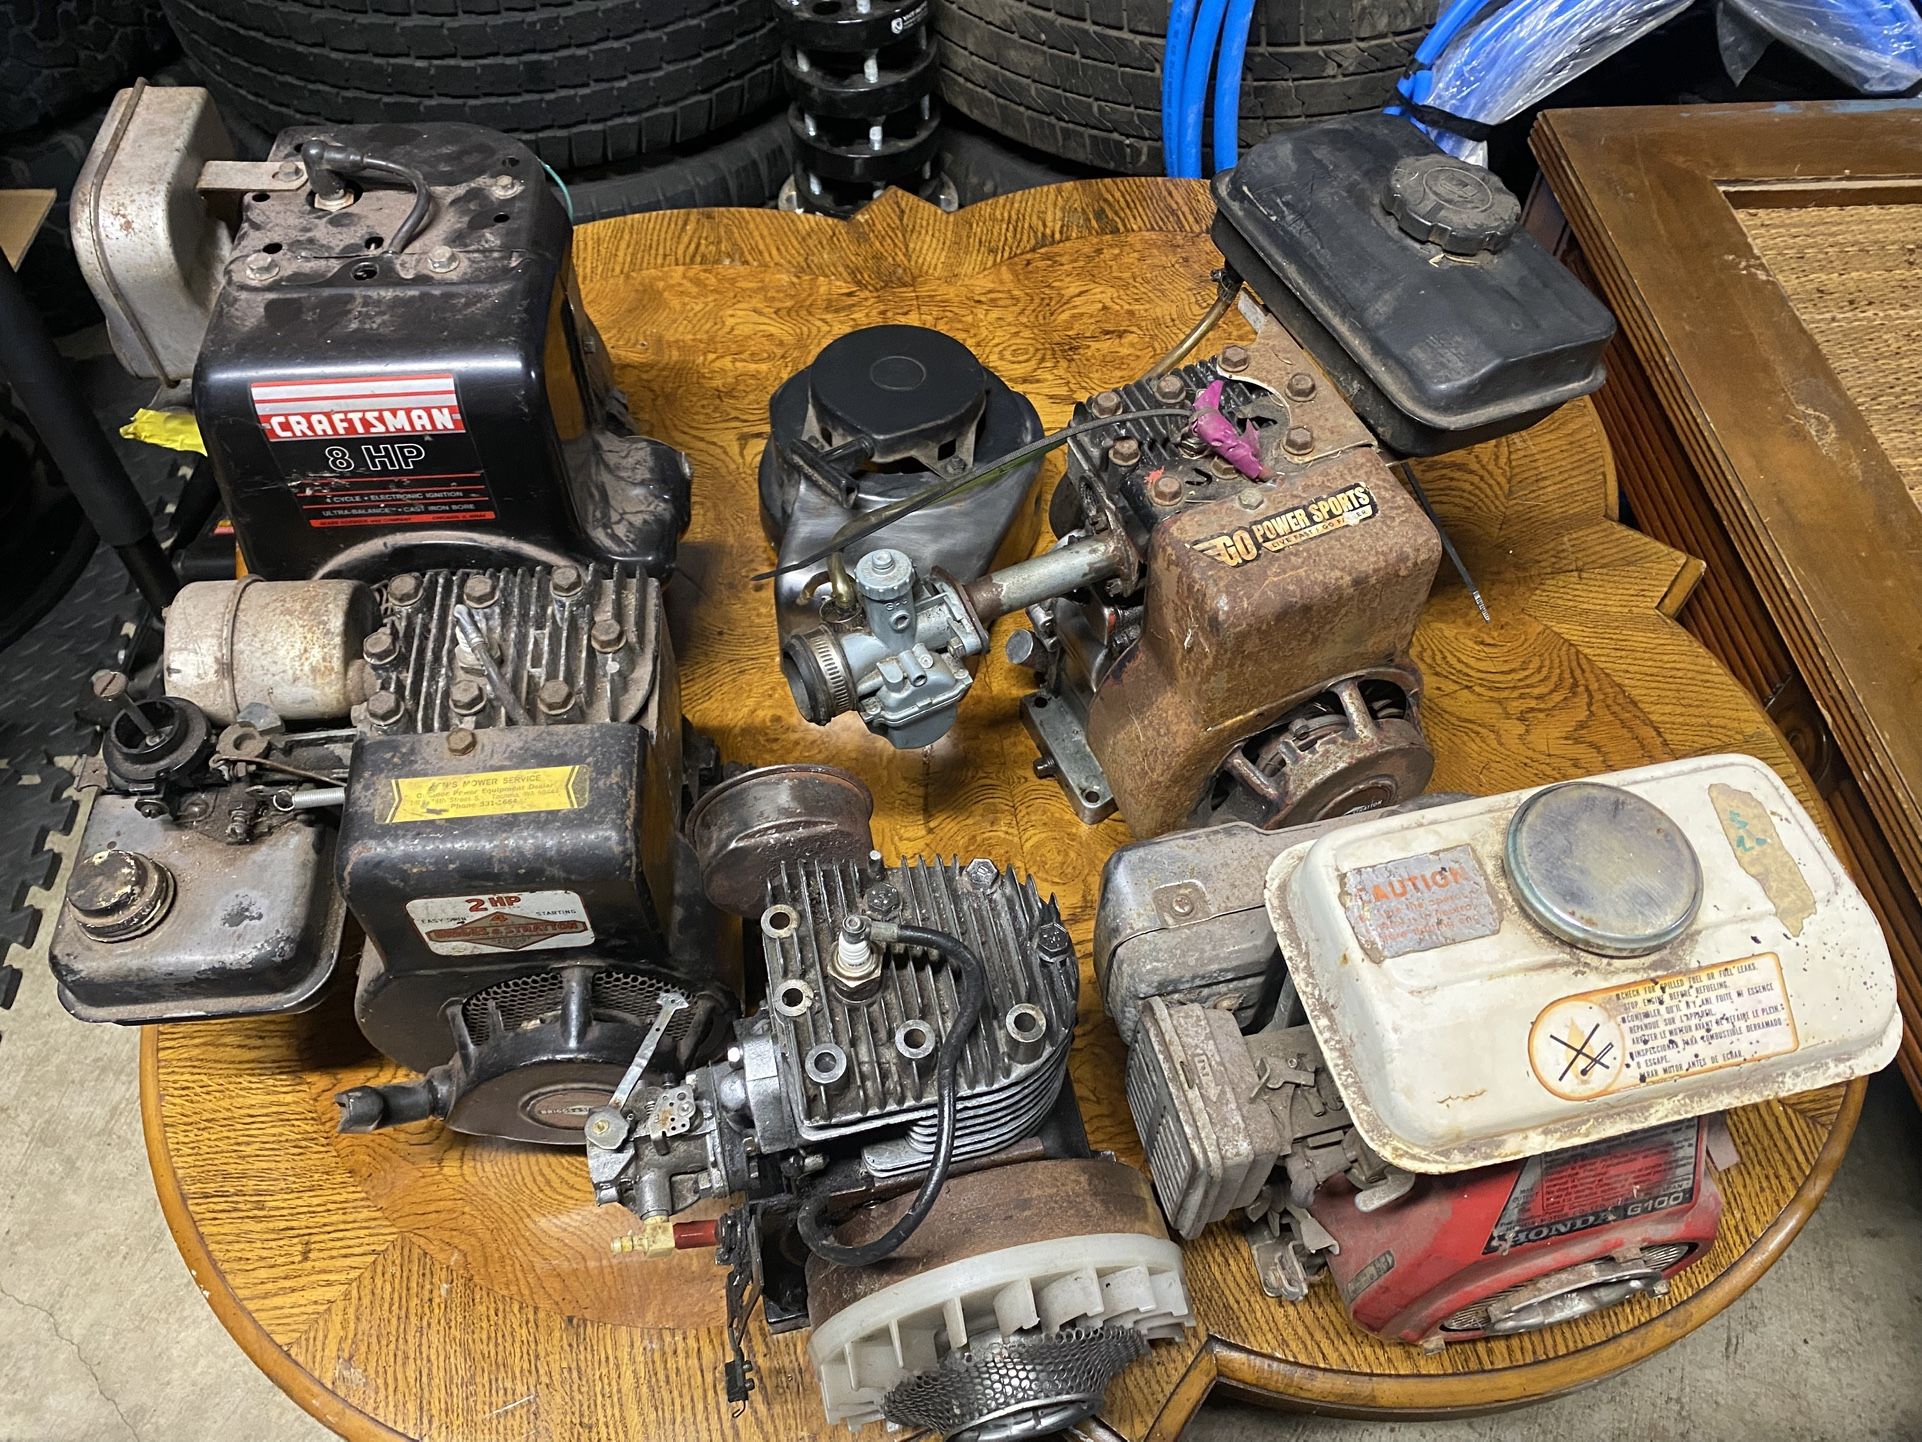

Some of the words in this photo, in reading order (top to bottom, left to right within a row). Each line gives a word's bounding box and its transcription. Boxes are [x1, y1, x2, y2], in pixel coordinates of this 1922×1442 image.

[269, 407, 455, 437] CRAFTSMAN
[325, 446, 355, 472] 8
[362, 443, 425, 470] HP
[1211, 529, 1258, 567] GO
[1252, 508, 1310, 543] POWER
[1308, 486, 1370, 523] SPORTS
[1272, 537, 1290, 548] LIVE
[1295, 528, 1313, 540] FAST
[503, 774, 541, 784] SERVICE
[536, 909, 577, 917] STARTING
[1621, 988, 1640, 1000] CHECK
[1644, 985, 1656, 994] FOR
[1688, 974, 1703, 985] FUEL
[1707, 972, 1716, 981] OR
[1747, 982, 1774, 996] ESSENCE
[1624, 1000, 1638, 1011] STOP
[1664, 1016, 1676, 1027] SUR
[1695, 1019, 1713, 1031] AVANT
[1752, 1008, 1760, 1018] LE
[1663, 1063, 1683, 1074] MOTOR
[1627, 1192, 1684, 1216] G100
